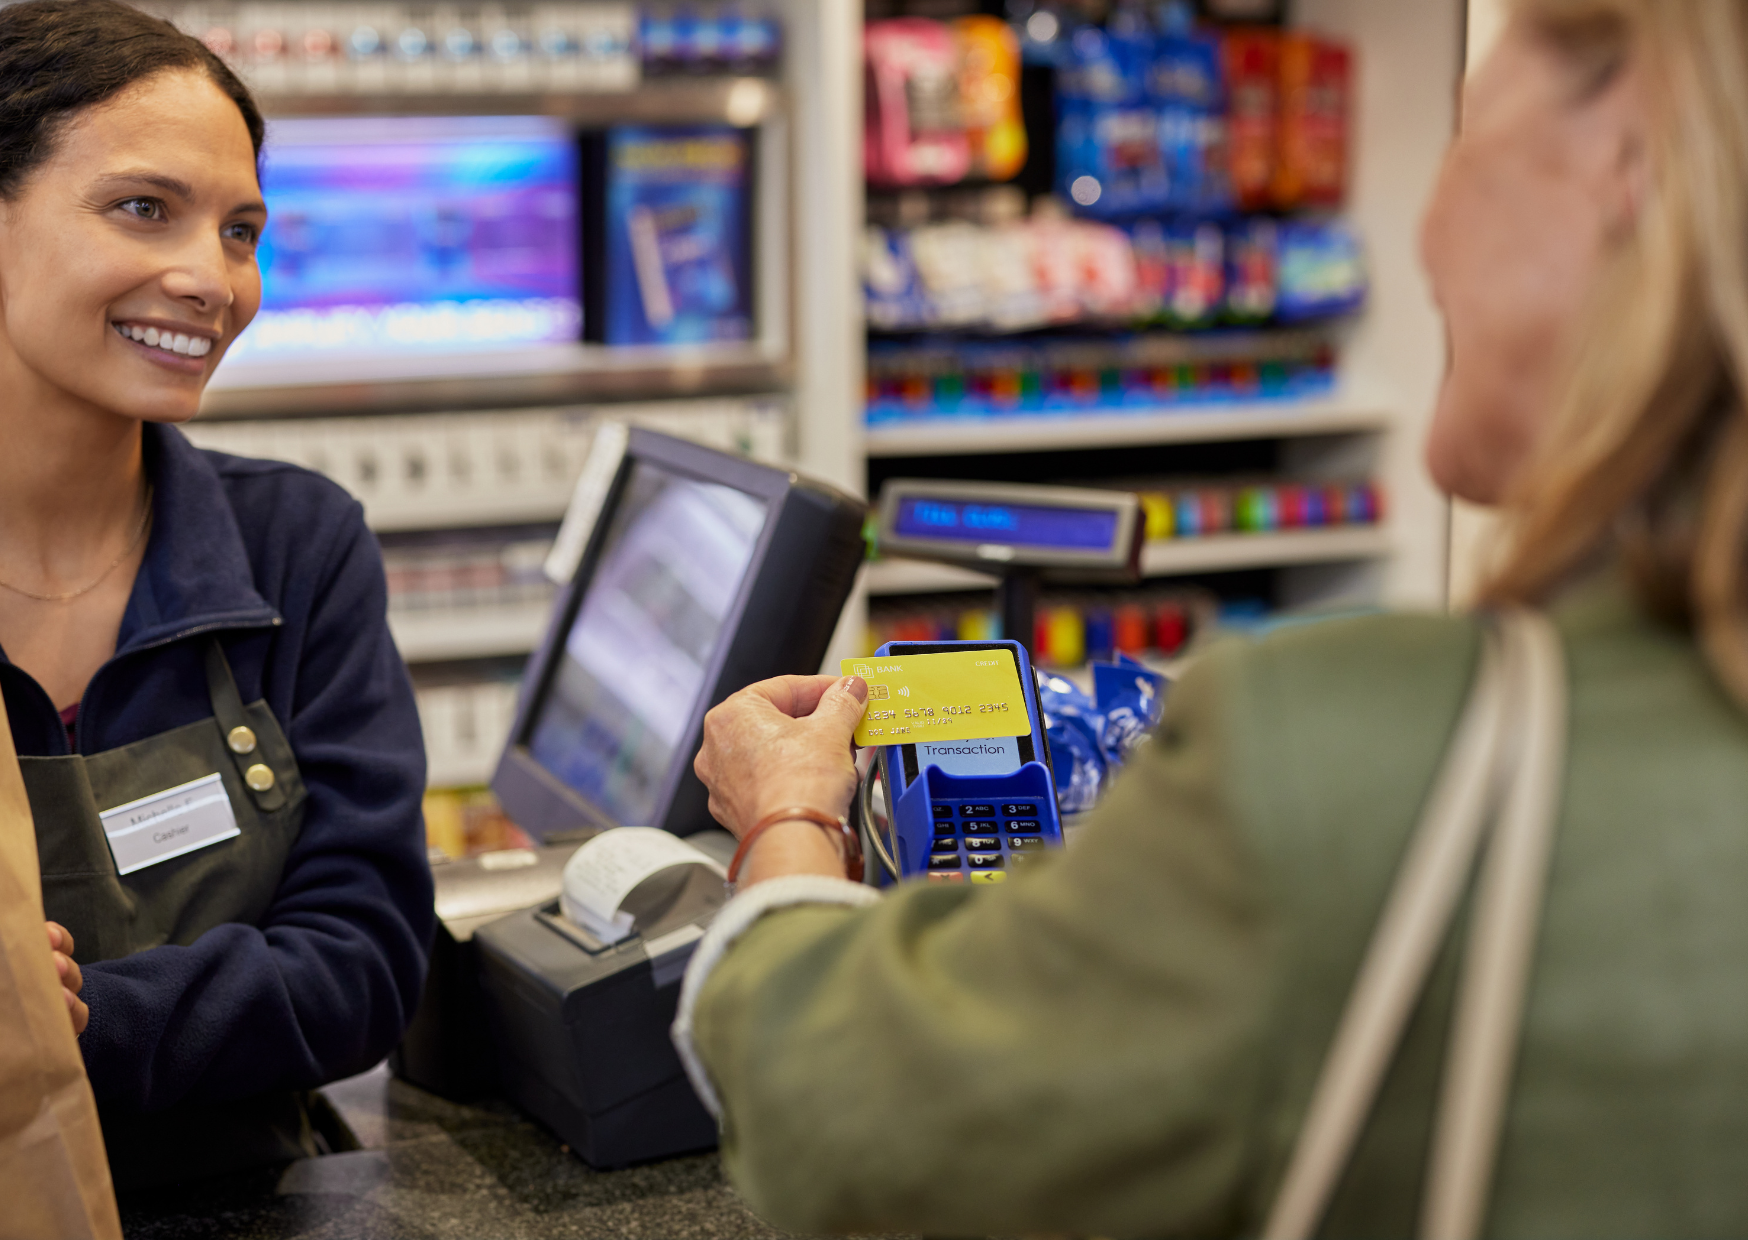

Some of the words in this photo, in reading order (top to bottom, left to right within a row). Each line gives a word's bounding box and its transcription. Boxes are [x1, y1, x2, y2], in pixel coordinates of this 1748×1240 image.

[876, 665, 903, 673] BANK
[867, 709, 896, 721] 1234
[904, 707, 935, 718] 5678
[942, 705, 972, 715] 9012
[979, 702, 1009, 713] 2345
[927, 717, 953, 725] 11/29
[890, 727, 911, 735] JANE
[924, 744, 1005, 756] Transaction
[965, 806, 973, 814] 2
[1008, 805, 1017, 813] 3
[970, 822, 978, 830] 5
[1010, 821, 1018, 829] 6
[153, 824, 190, 844] Cashier
[972, 838, 980, 847] 8
[1013, 838, 1022, 846] 9
[974, 856, 983, 864] 0
